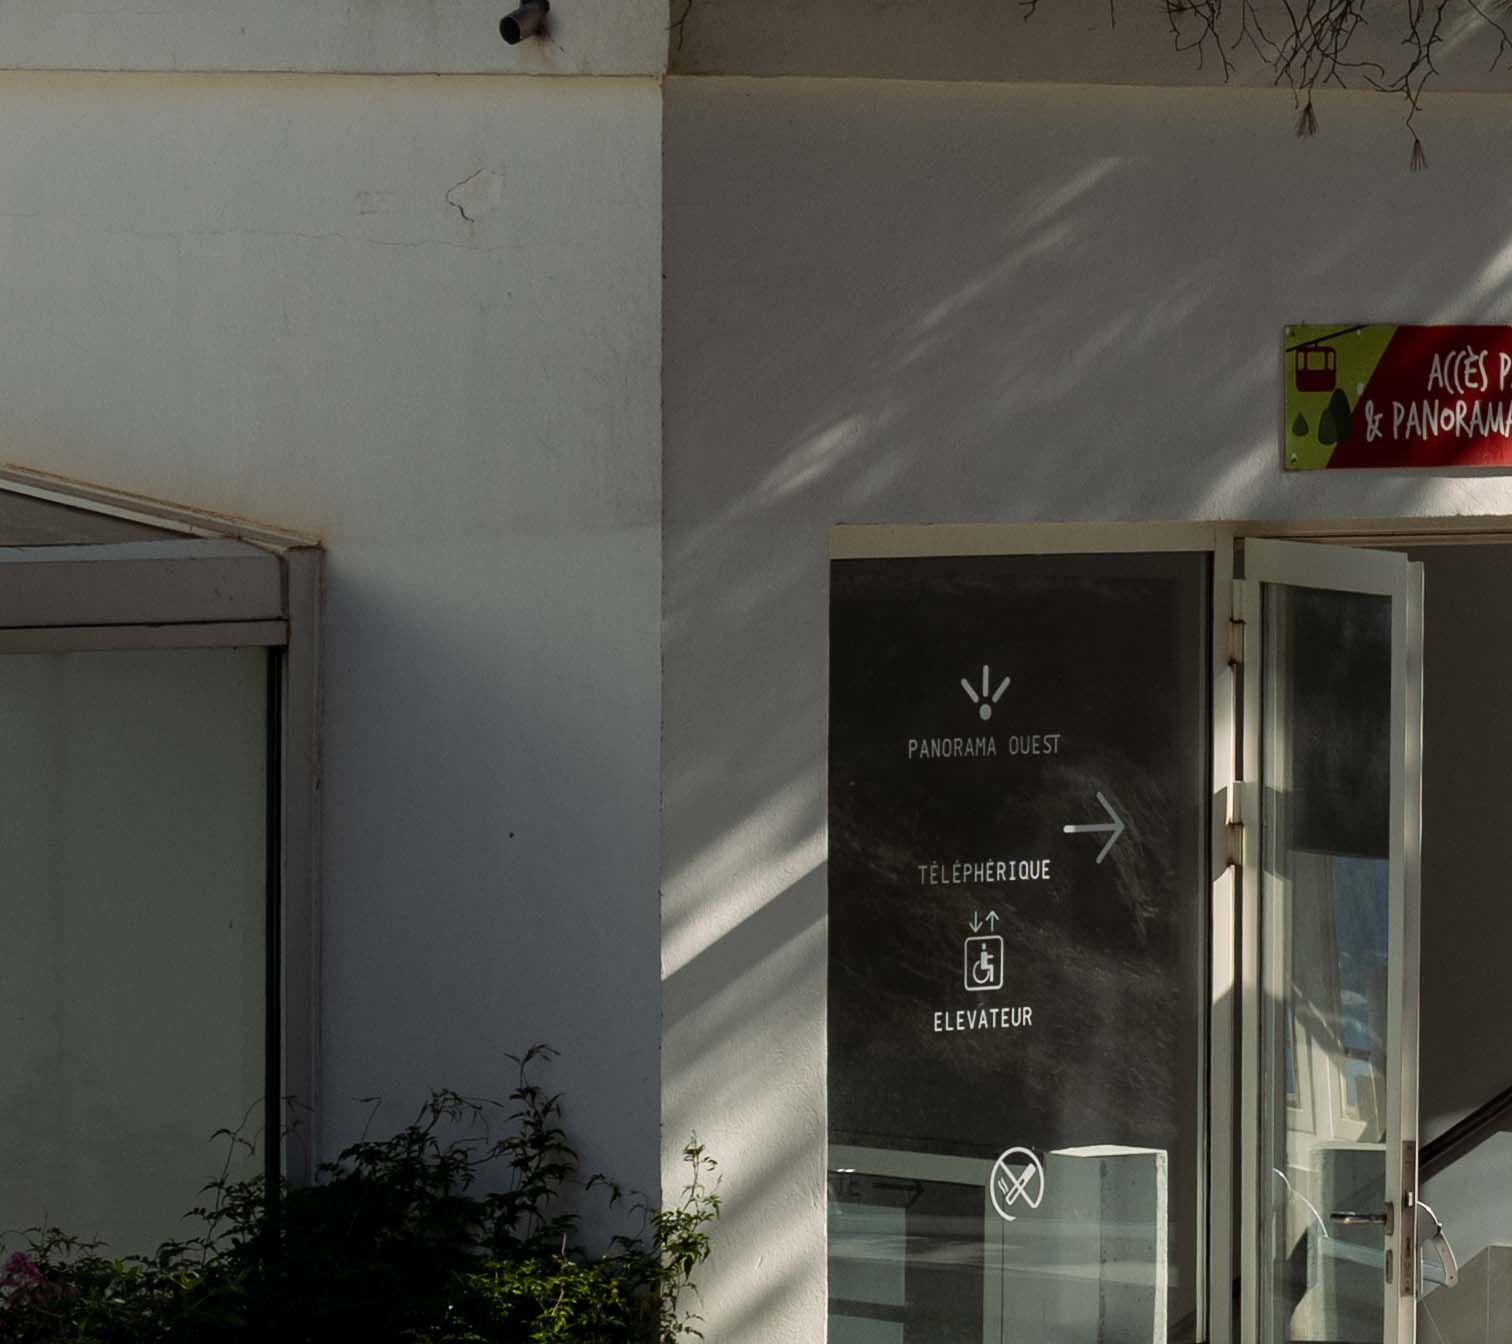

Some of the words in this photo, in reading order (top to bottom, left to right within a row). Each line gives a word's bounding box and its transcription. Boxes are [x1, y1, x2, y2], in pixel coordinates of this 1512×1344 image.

[1427, 344, 1489, 394] ACCÈS
[1364, 401, 1384, 443] &
[907, 737, 997, 759] PANORAMA
[1008, 733, 1062, 755] OUEST
[918, 859, 1052, 886] TÉLÉPHÉRIQUE
[934, 1006, 1033, 1032] ELEVATEUR
